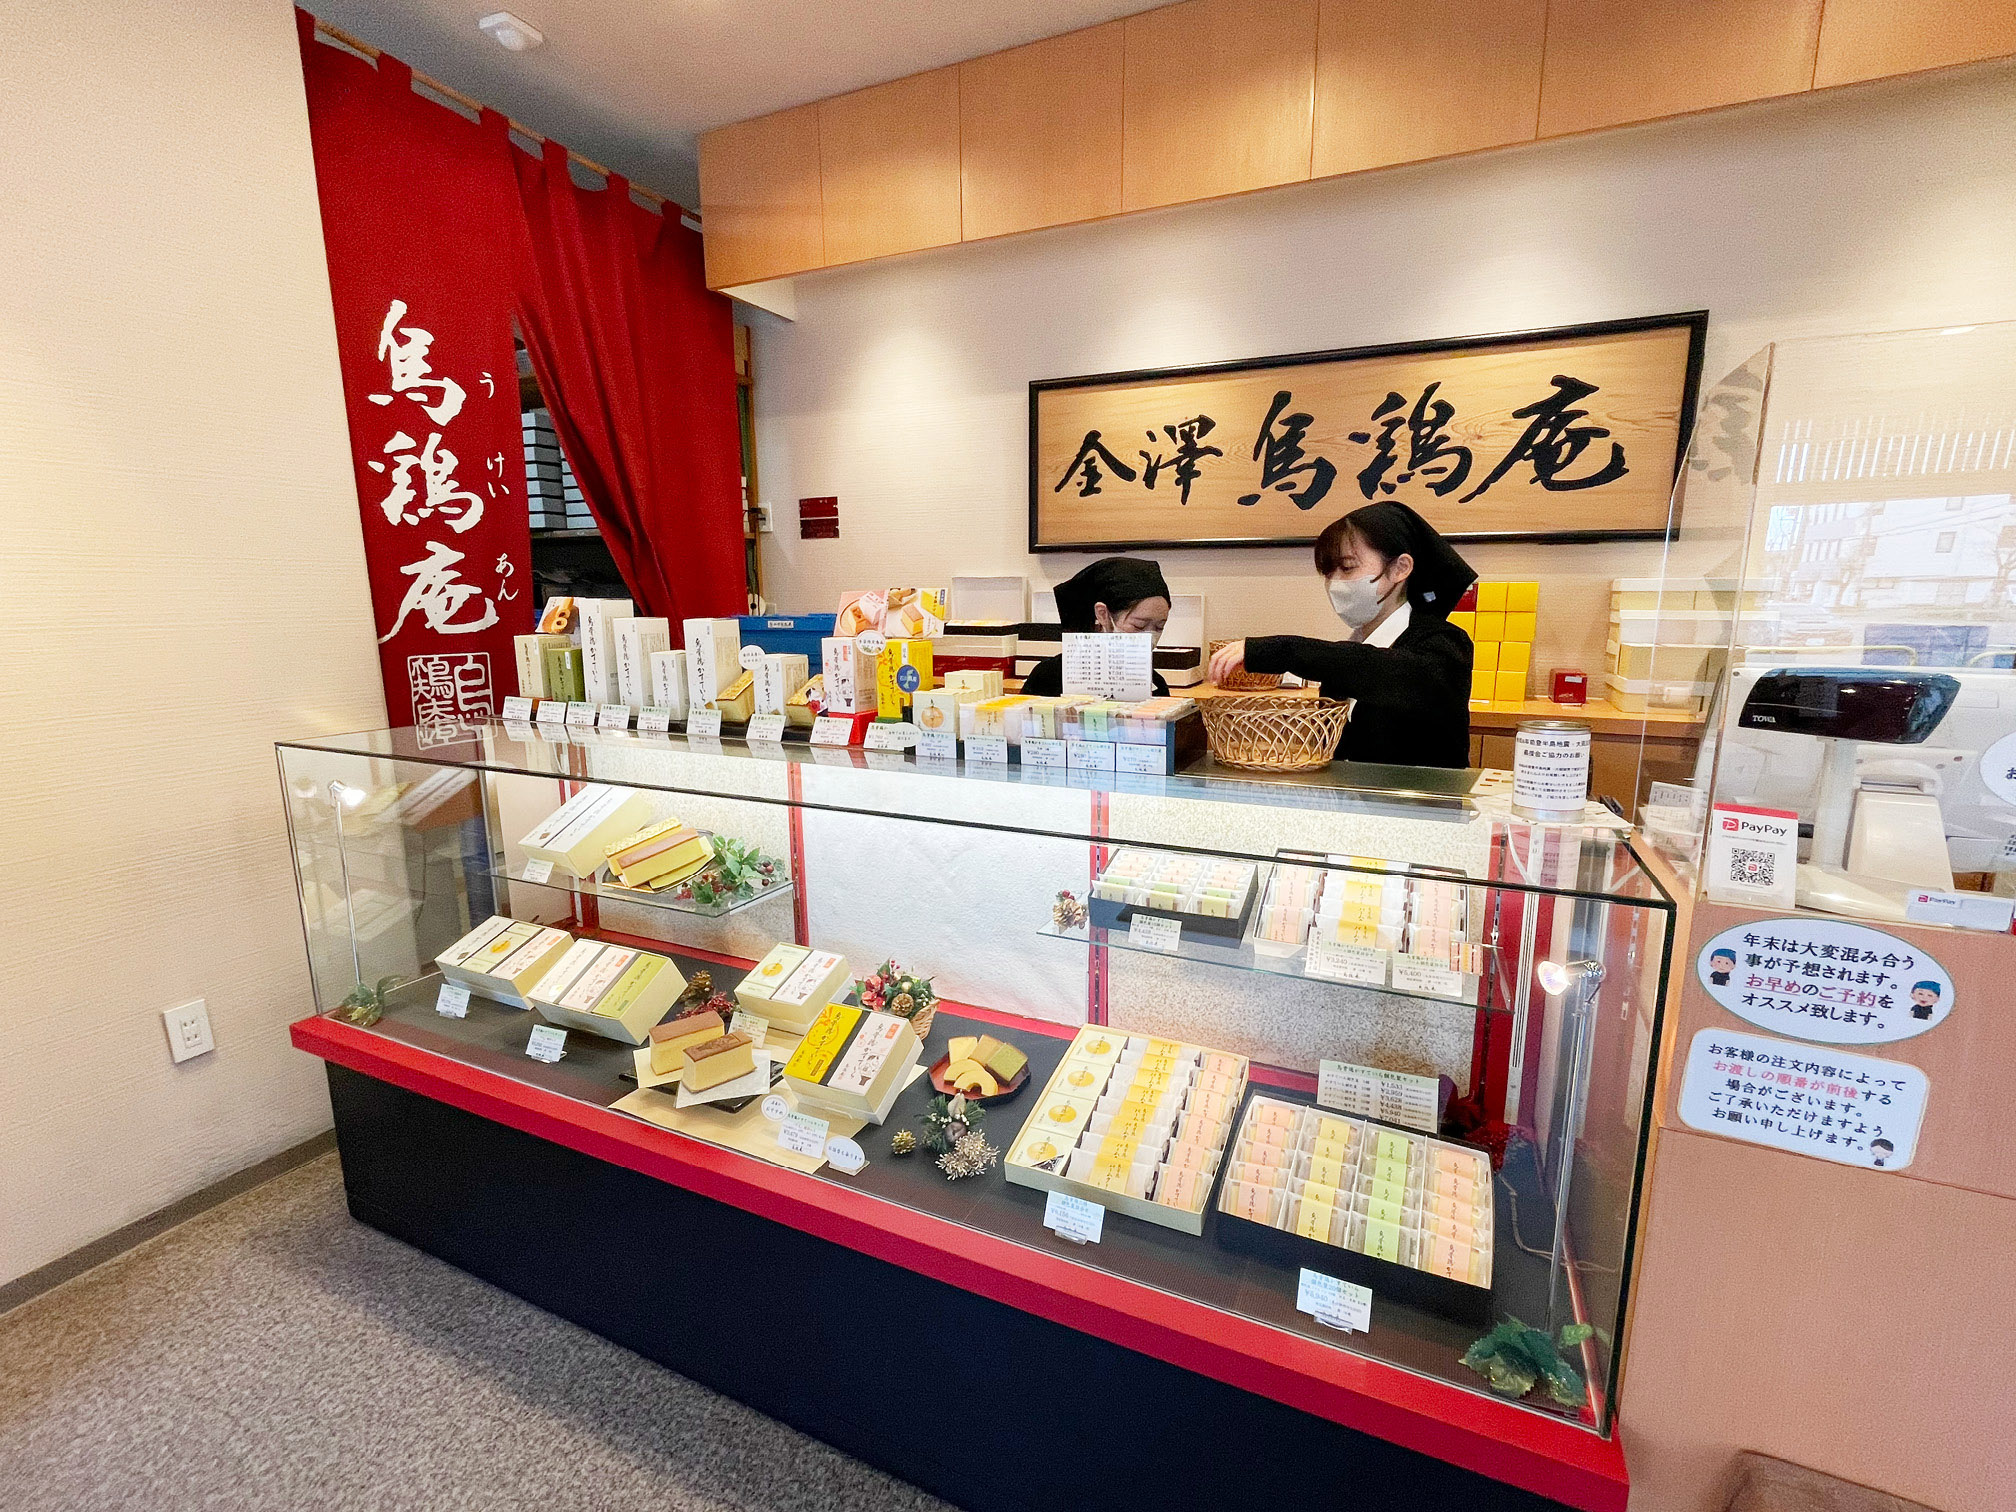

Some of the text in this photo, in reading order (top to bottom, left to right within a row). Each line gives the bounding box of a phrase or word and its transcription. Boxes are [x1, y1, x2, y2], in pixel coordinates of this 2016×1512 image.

[479, 371, 519, 601] う けい あん
[1741, 820, 1787, 837] PayPay
[1743, 933, 1915, 970] 年末は大変混み合う
[1745, 953, 1899, 990] 事が予想されます。
[1745, 974, 1895, 1009] お早めのご予約を
[1742, 993, 1886, 1029] オススメ致します。
[1708, 1044, 1907, 1092] お客様の注文内容によって
[1713, 1060, 1893, 1105] お渡しの順番が前後する
[1708, 1091, 1883, 1137] ご了承いただけますよう
[1725, 1079, 1863, 1117] 場合がございます。
[1713, 1108, 1865, 1151] お願い申し上げます。
